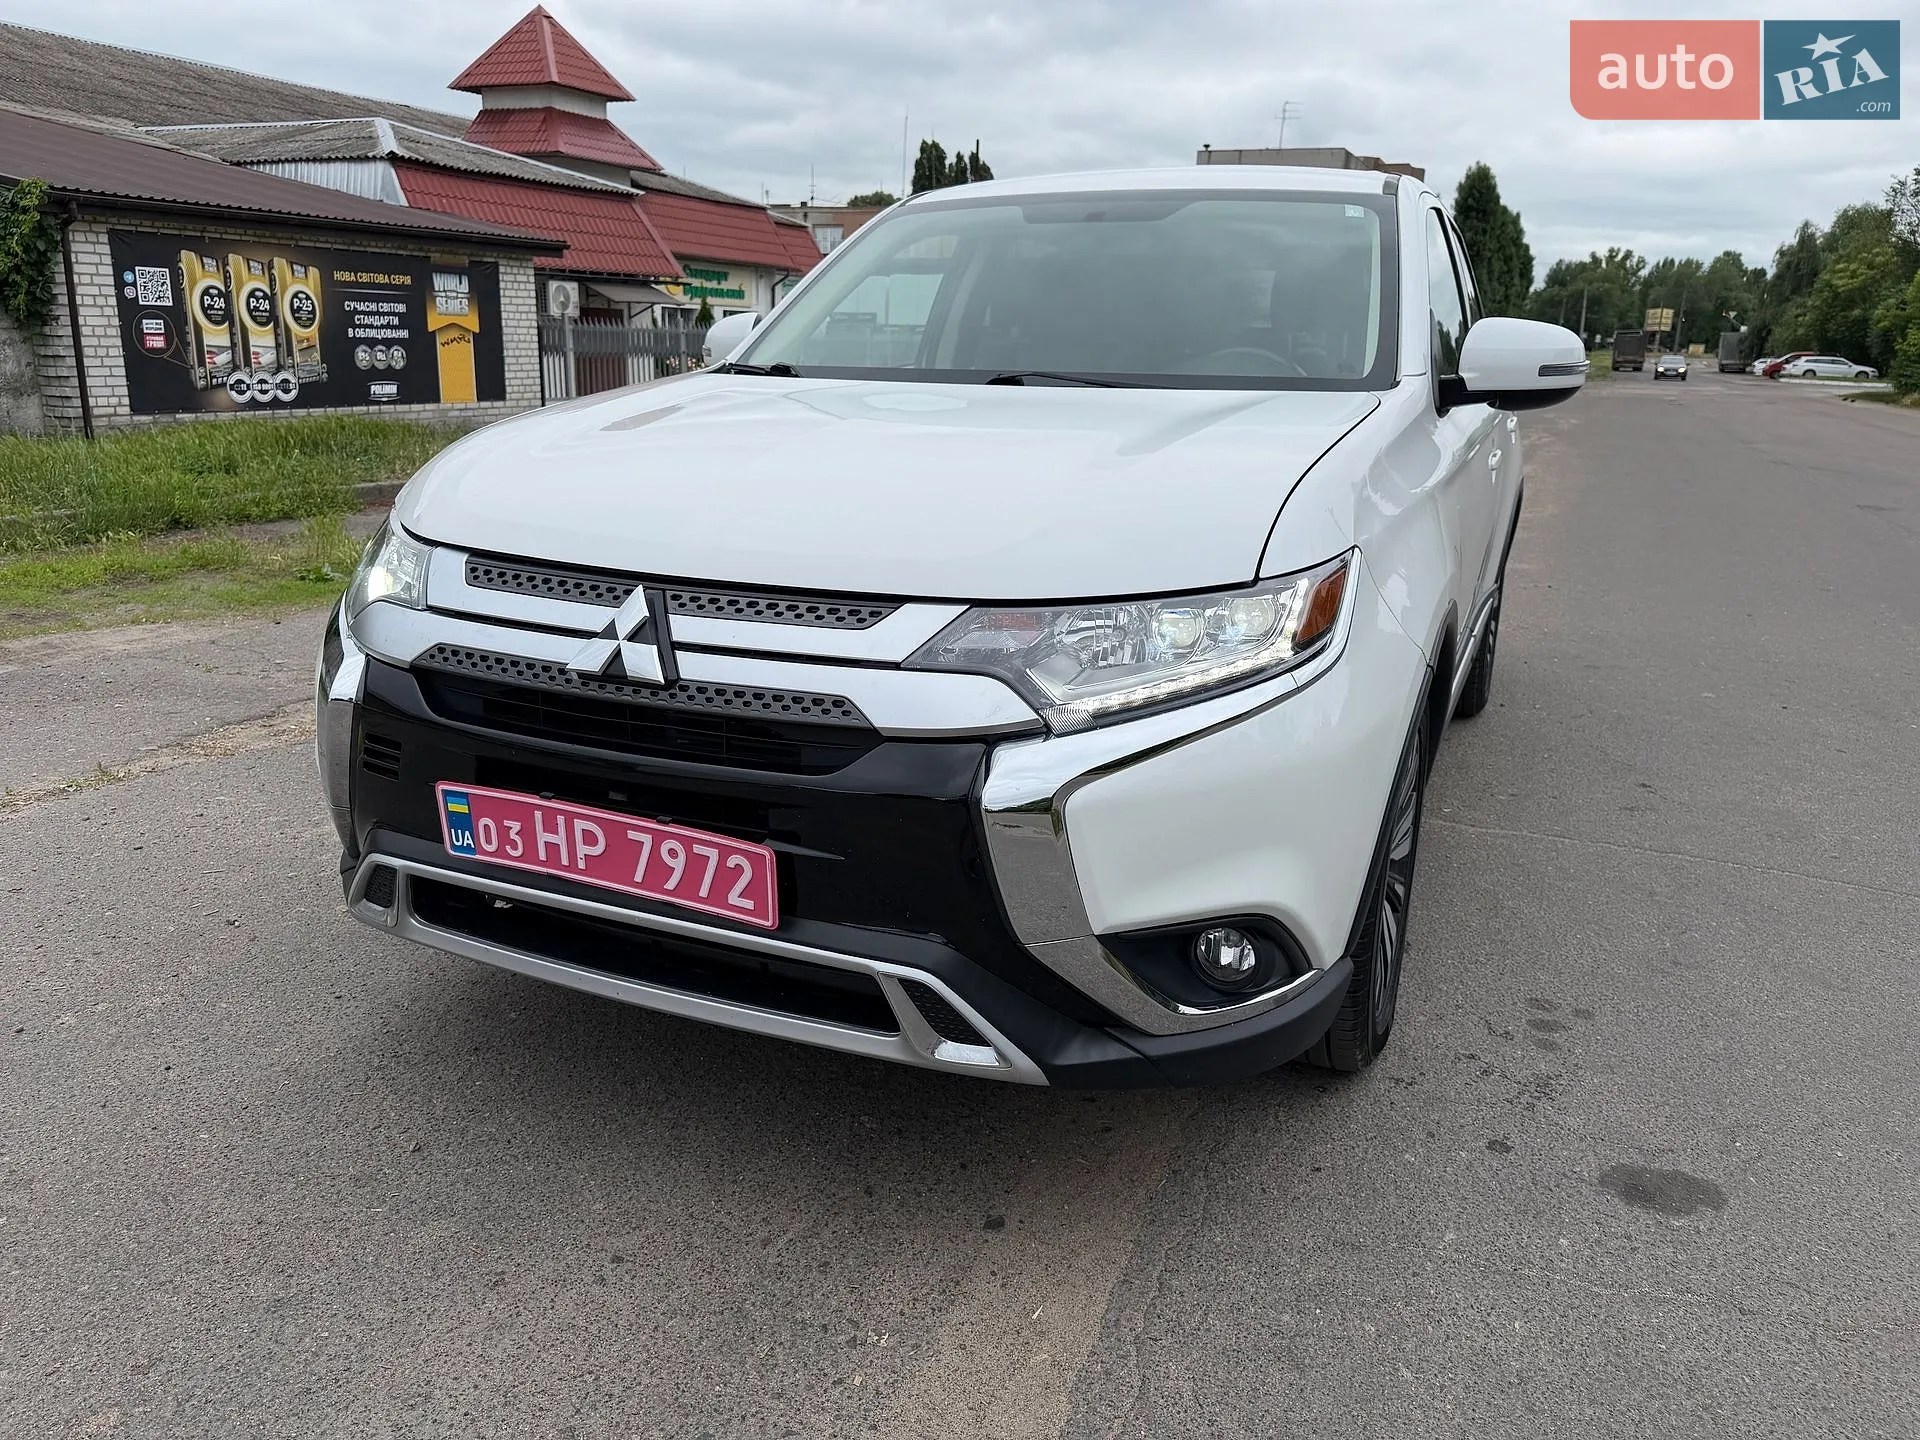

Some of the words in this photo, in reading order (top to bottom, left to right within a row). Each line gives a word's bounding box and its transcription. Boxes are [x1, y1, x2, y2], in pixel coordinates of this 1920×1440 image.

[333, 270, 356, 281] НОВА
[357, 272, 390, 284] СВІТОВА
[390, 274, 412, 285] СЕРІЯ
[432, 272, 469, 293] WORLD
[203, 295, 226, 310] P-24
[249, 297, 270, 311] P-24
[293, 298, 313, 311] P-25
[344, 300, 377, 312] СУЧАСНІ
[378, 302, 407, 313] СВІТОВІ
[436, 296, 469, 315] SERIES
[354, 314, 399, 327] СТАНДАРТИ
[347, 328, 354, 338] В
[354, 328, 409, 340] ОБЛИЦЮВАННІ
[450, 828, 475, 849] UA
[477, 817, 524, 857] 03
[534, 810, 607, 870] HP
[626, 830, 755, 910] 7972
